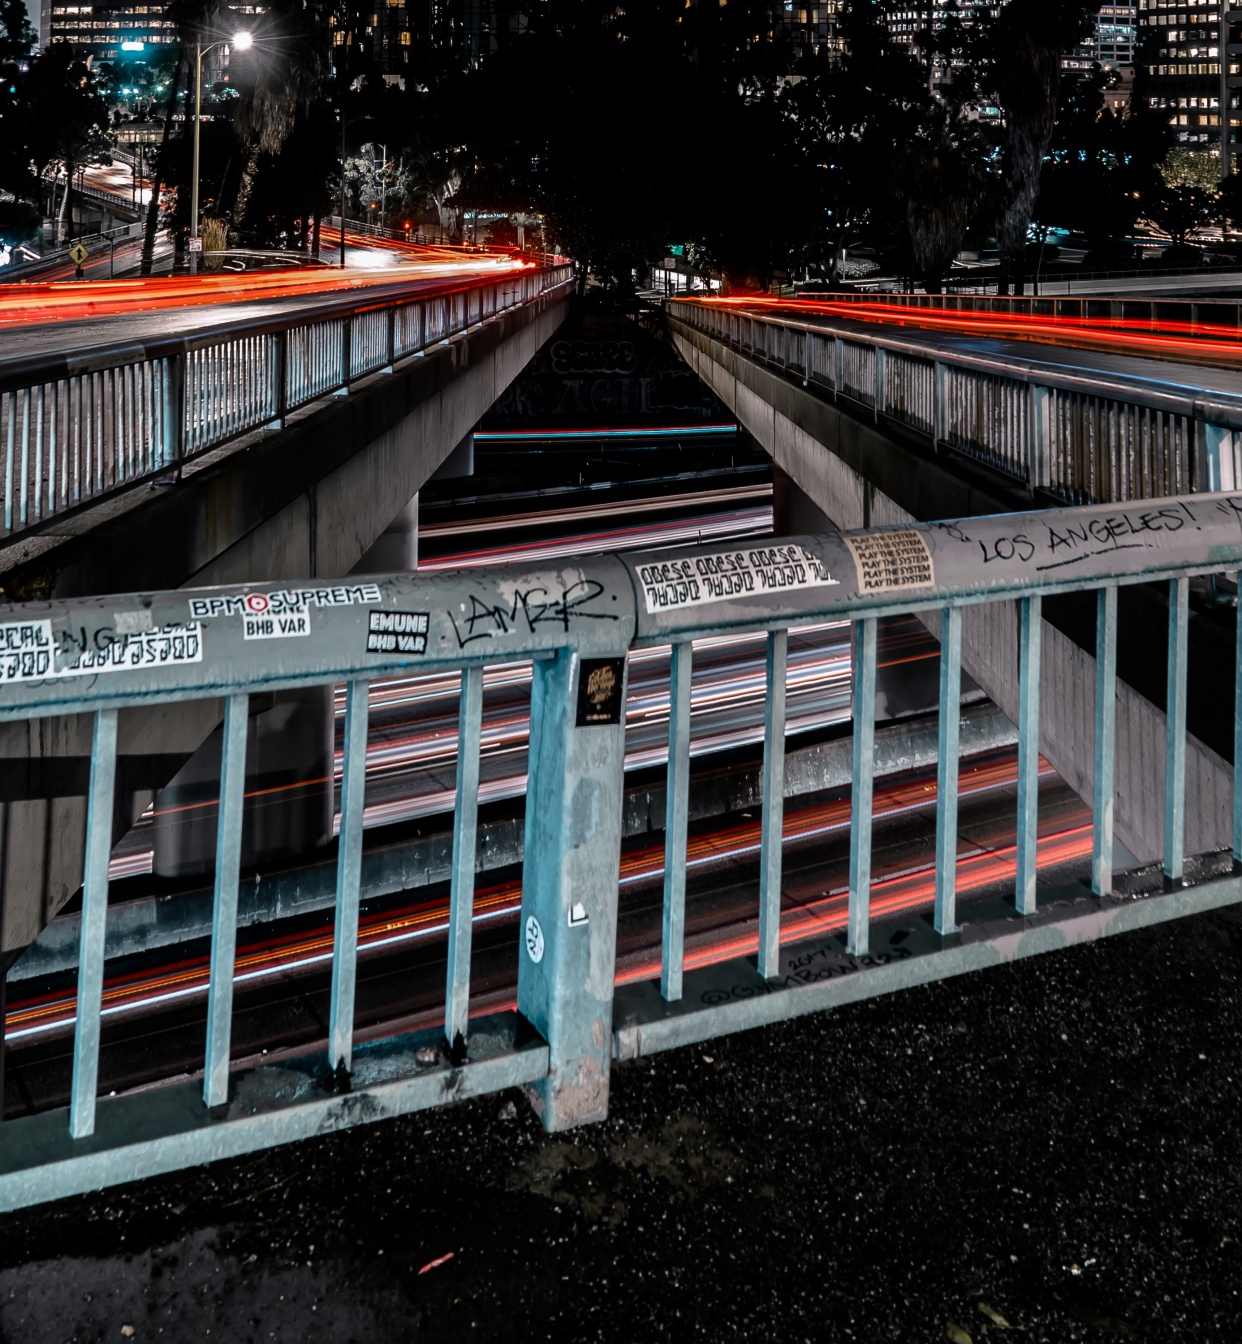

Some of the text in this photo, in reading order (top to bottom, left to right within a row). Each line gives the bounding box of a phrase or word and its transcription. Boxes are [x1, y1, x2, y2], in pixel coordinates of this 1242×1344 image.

[887, 532, 917, 540] SYSTEM
[854, 544, 874, 552] PLAY
[892, 538, 922, 548] SYSTEM
[979, 534, 1035, 564] LOS
[858, 552, 878, 560] PLAY
[896, 547, 926, 556] SYSTEM
[862, 555, 929, 569] PLAY THE SYSTEM
[864, 564, 930, 579] PLAY THE SYSTEM
[864, 574, 931, 588] PLAY THE SYSTEM
[246, 618, 306, 636] BHB VAR
[369, 613, 427, 633] EMUNE
[397, 635, 425, 651] VAR
